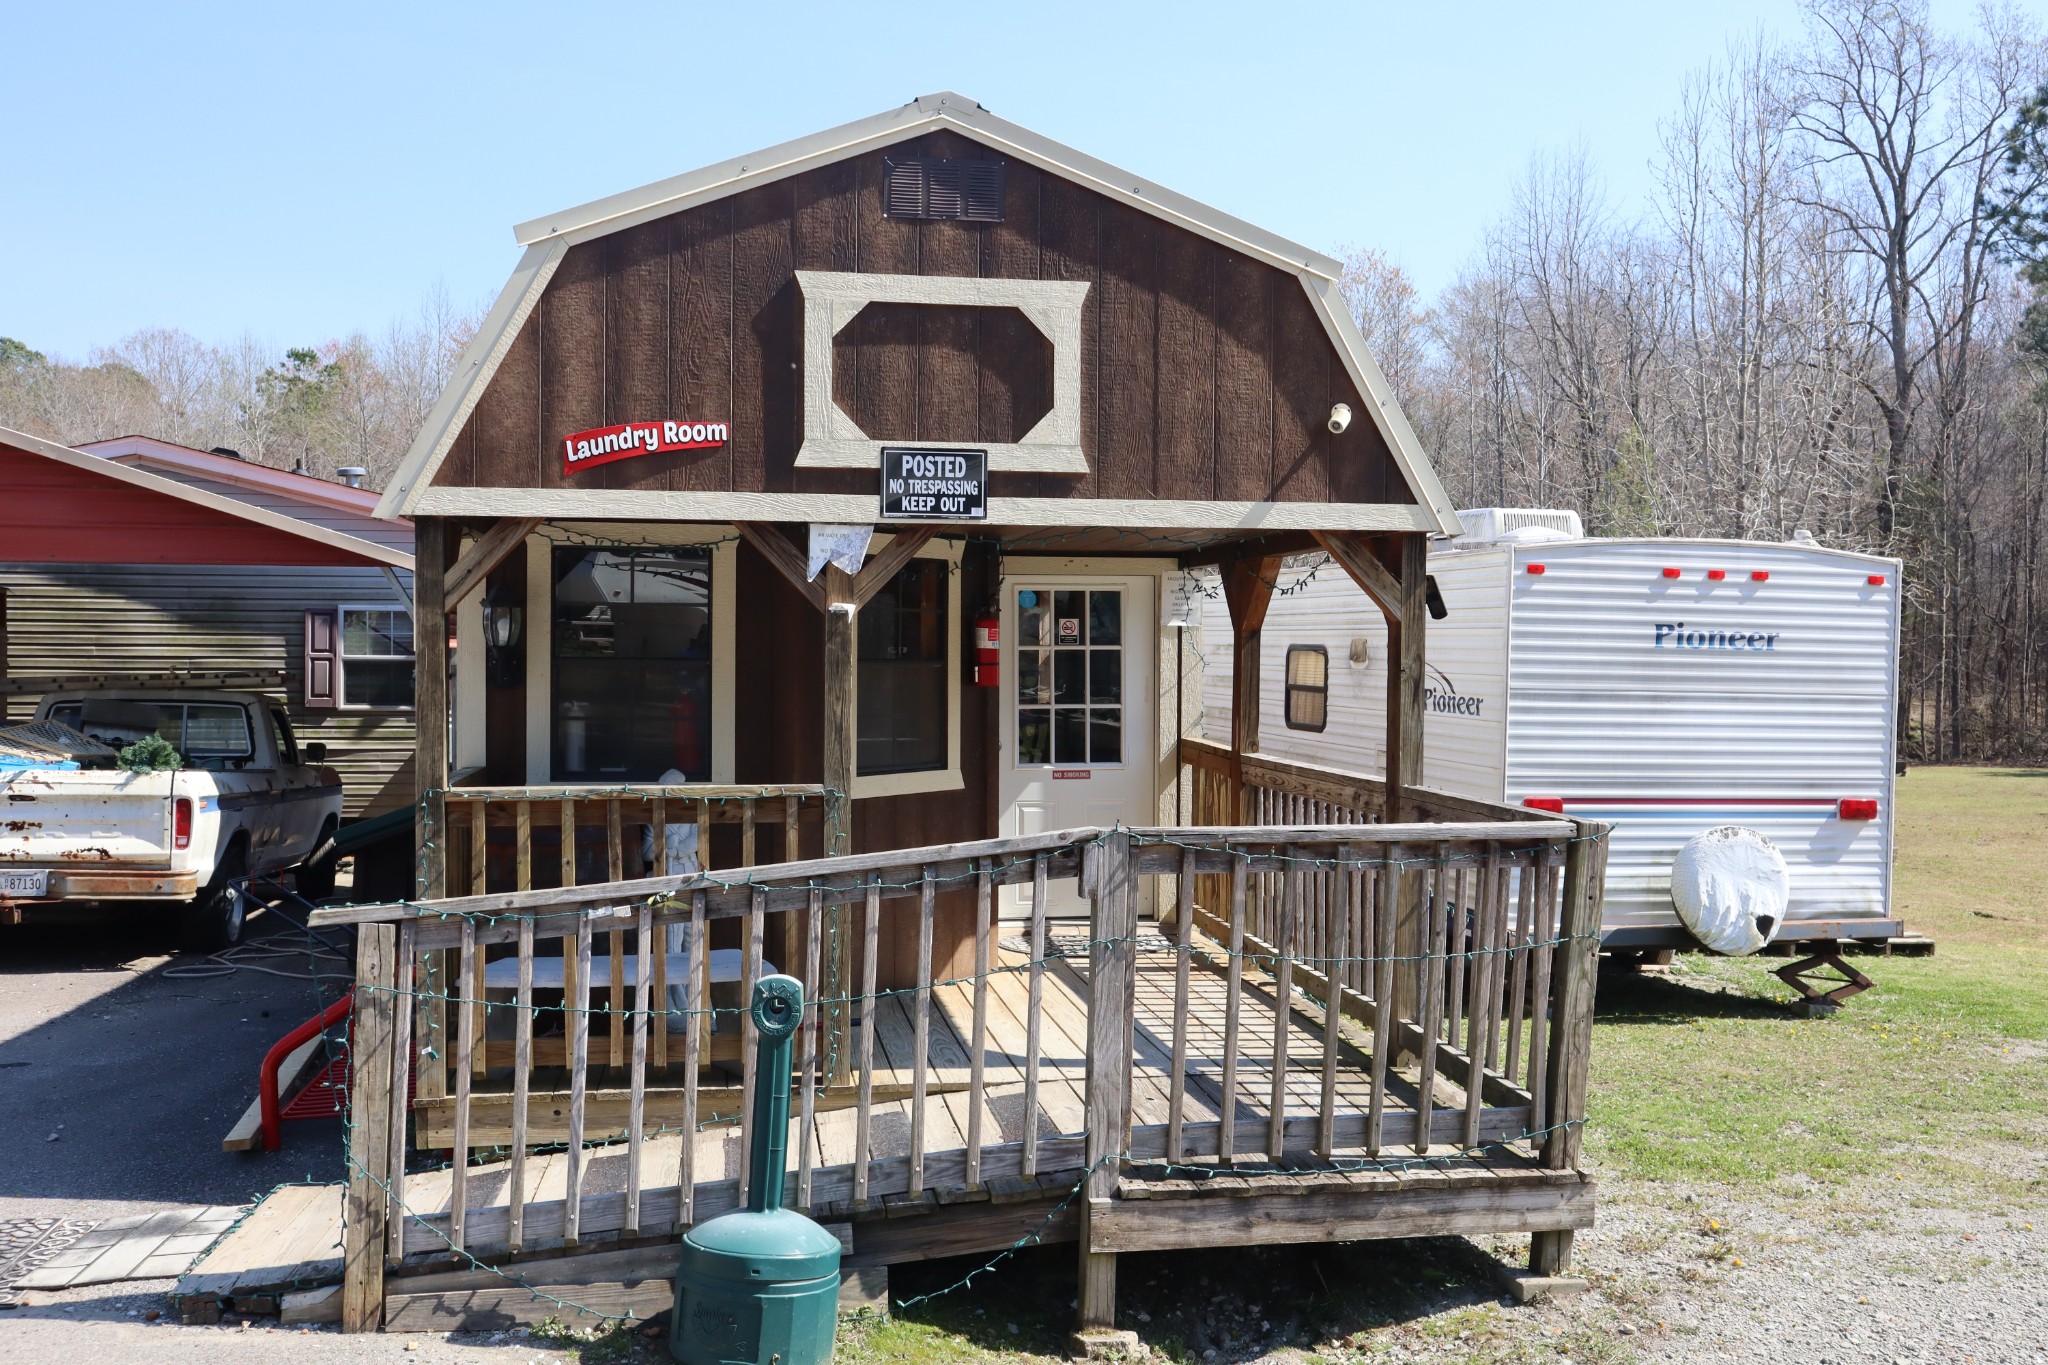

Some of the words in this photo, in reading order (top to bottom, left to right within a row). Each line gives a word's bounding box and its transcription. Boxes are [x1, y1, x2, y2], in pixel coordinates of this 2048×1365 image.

[565, 426, 659, 462] Laundry
[663, 421, 728, 444] Room
[902, 455, 967, 478] POSTED
[889, 479, 904, 494] NO
[908, 479, 978, 495] TRESPASSING
[901, 496, 935, 511] KEEP
[940, 497, 966, 512] OUT
[1654, 621, 1780, 651] Pioneer
[1424, 687, 1484, 716] Pioneer
[9, 878, 41, 890] 87130
